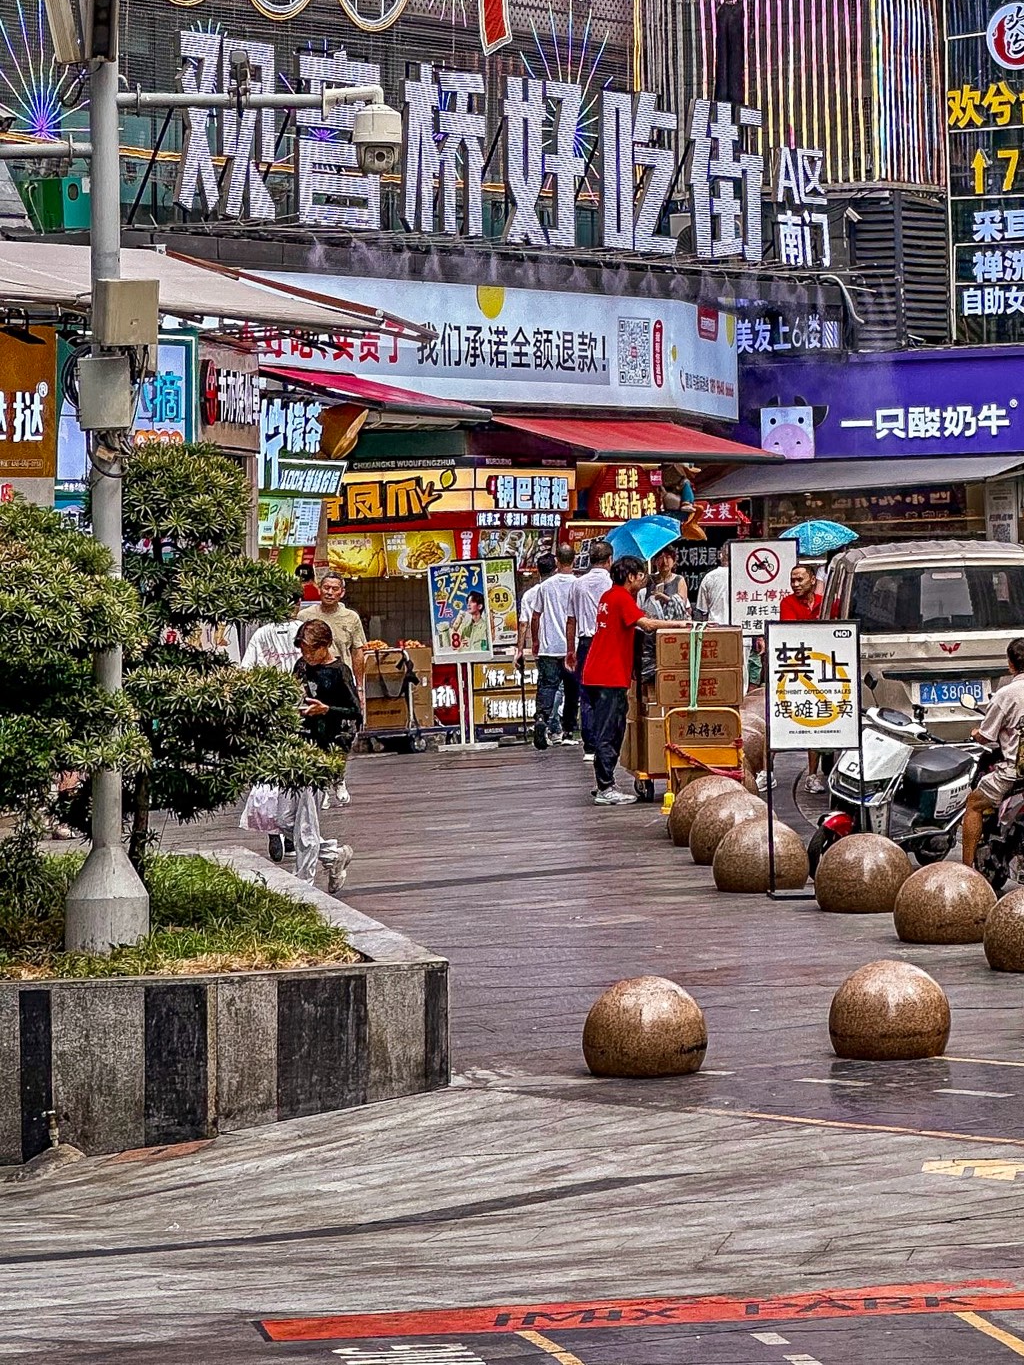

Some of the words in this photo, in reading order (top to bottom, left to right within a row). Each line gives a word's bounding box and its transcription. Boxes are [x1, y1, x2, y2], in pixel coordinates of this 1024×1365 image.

[173, 31, 765, 263] 观音桥好吃街
[777, 146, 827, 206] A区
[779, 211, 831, 268] 南门
[840, 404, 1011, 439] 一只酸奶牛
[774, 641, 852, 683] 禁止
[774, 698, 853, 719] 摆摊售卖
